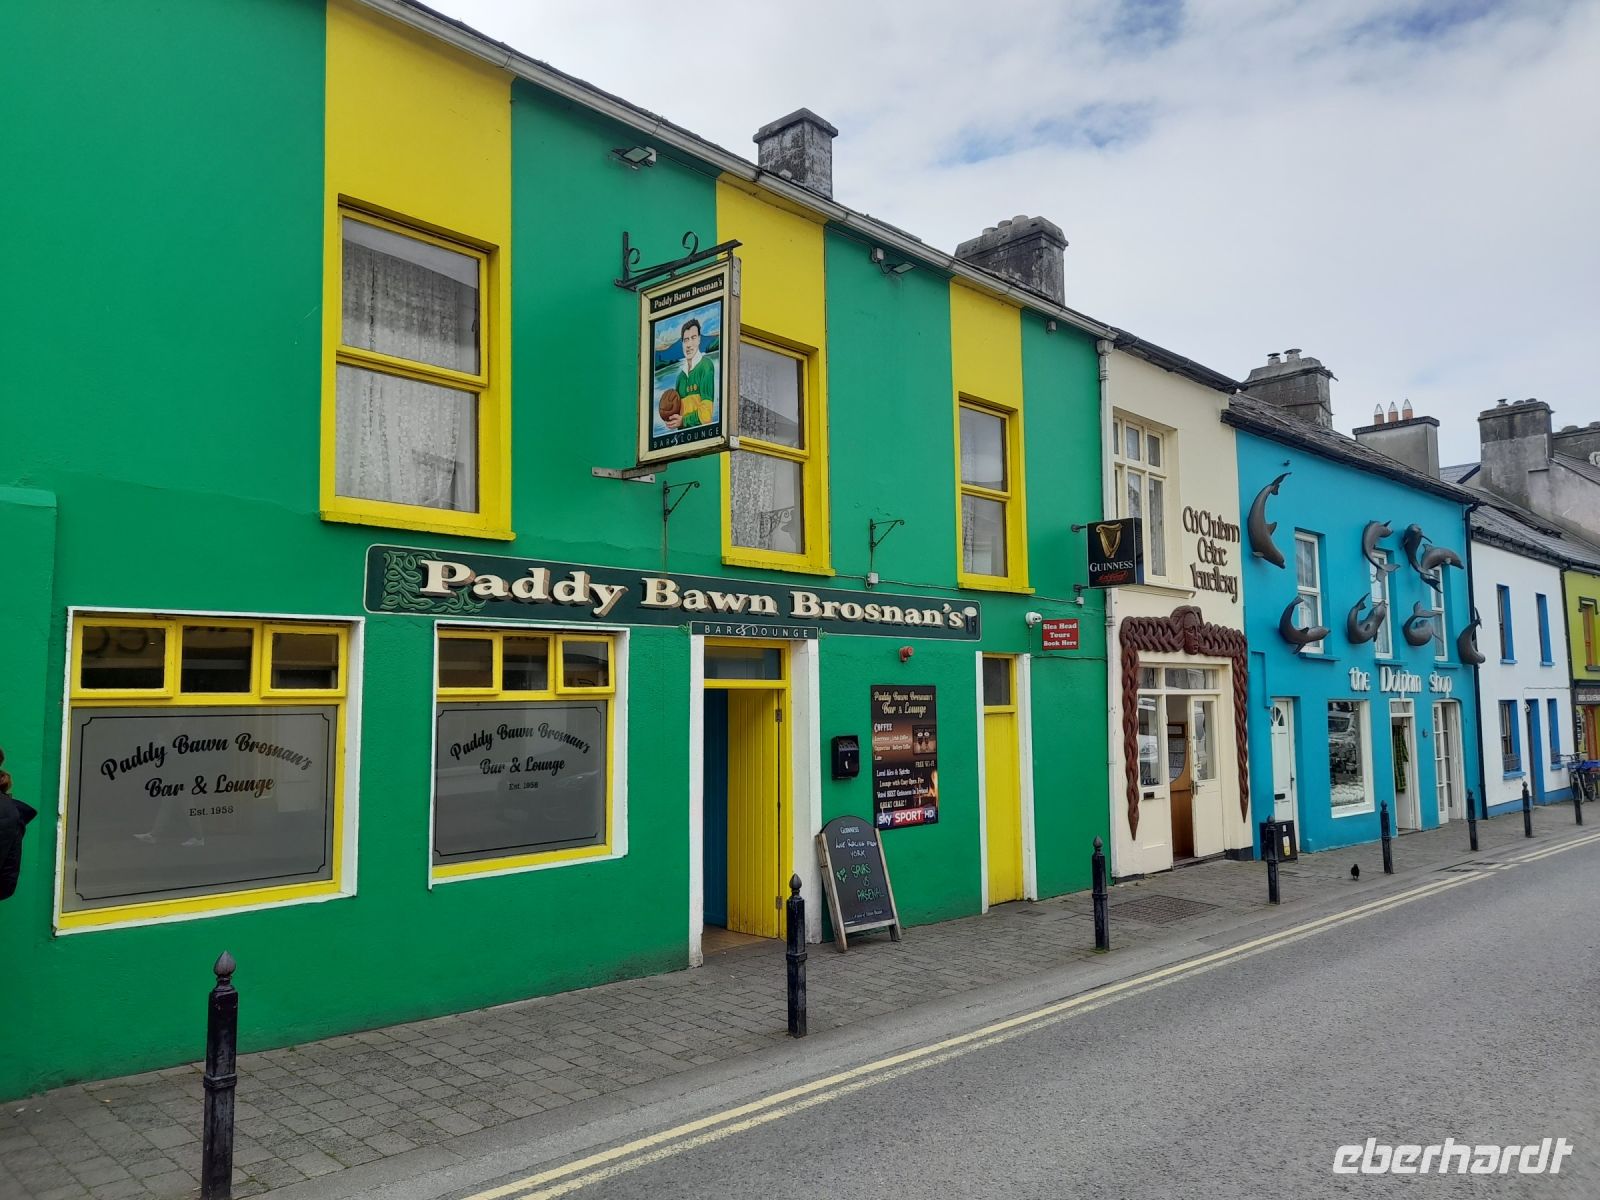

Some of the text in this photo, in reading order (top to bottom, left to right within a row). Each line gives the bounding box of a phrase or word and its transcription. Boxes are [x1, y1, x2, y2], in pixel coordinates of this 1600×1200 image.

[654, 296, 672, 308] Paddy
[674, 291, 690, 302] Bawn
[1090, 560, 1134, 572] GUINNESS
[420, 560, 965, 628] Paddy Bawn Brosnan's
[704, 625, 732, 634] BAR
[752, 628, 808, 638] LOUNGE
[1349, 666, 1370, 690] the
[450, 722, 590, 760] Paddy Bawn Brosnan's
[101, 733, 313, 780] Paddy Bawn Brosnan's
[480, 756, 565, 776] Bar & Lounge
[145, 774, 274, 798] Bar & Lounge
[189, 806, 234, 816] Est. 1958
[878, 810, 934, 826] sky SPORT HD
